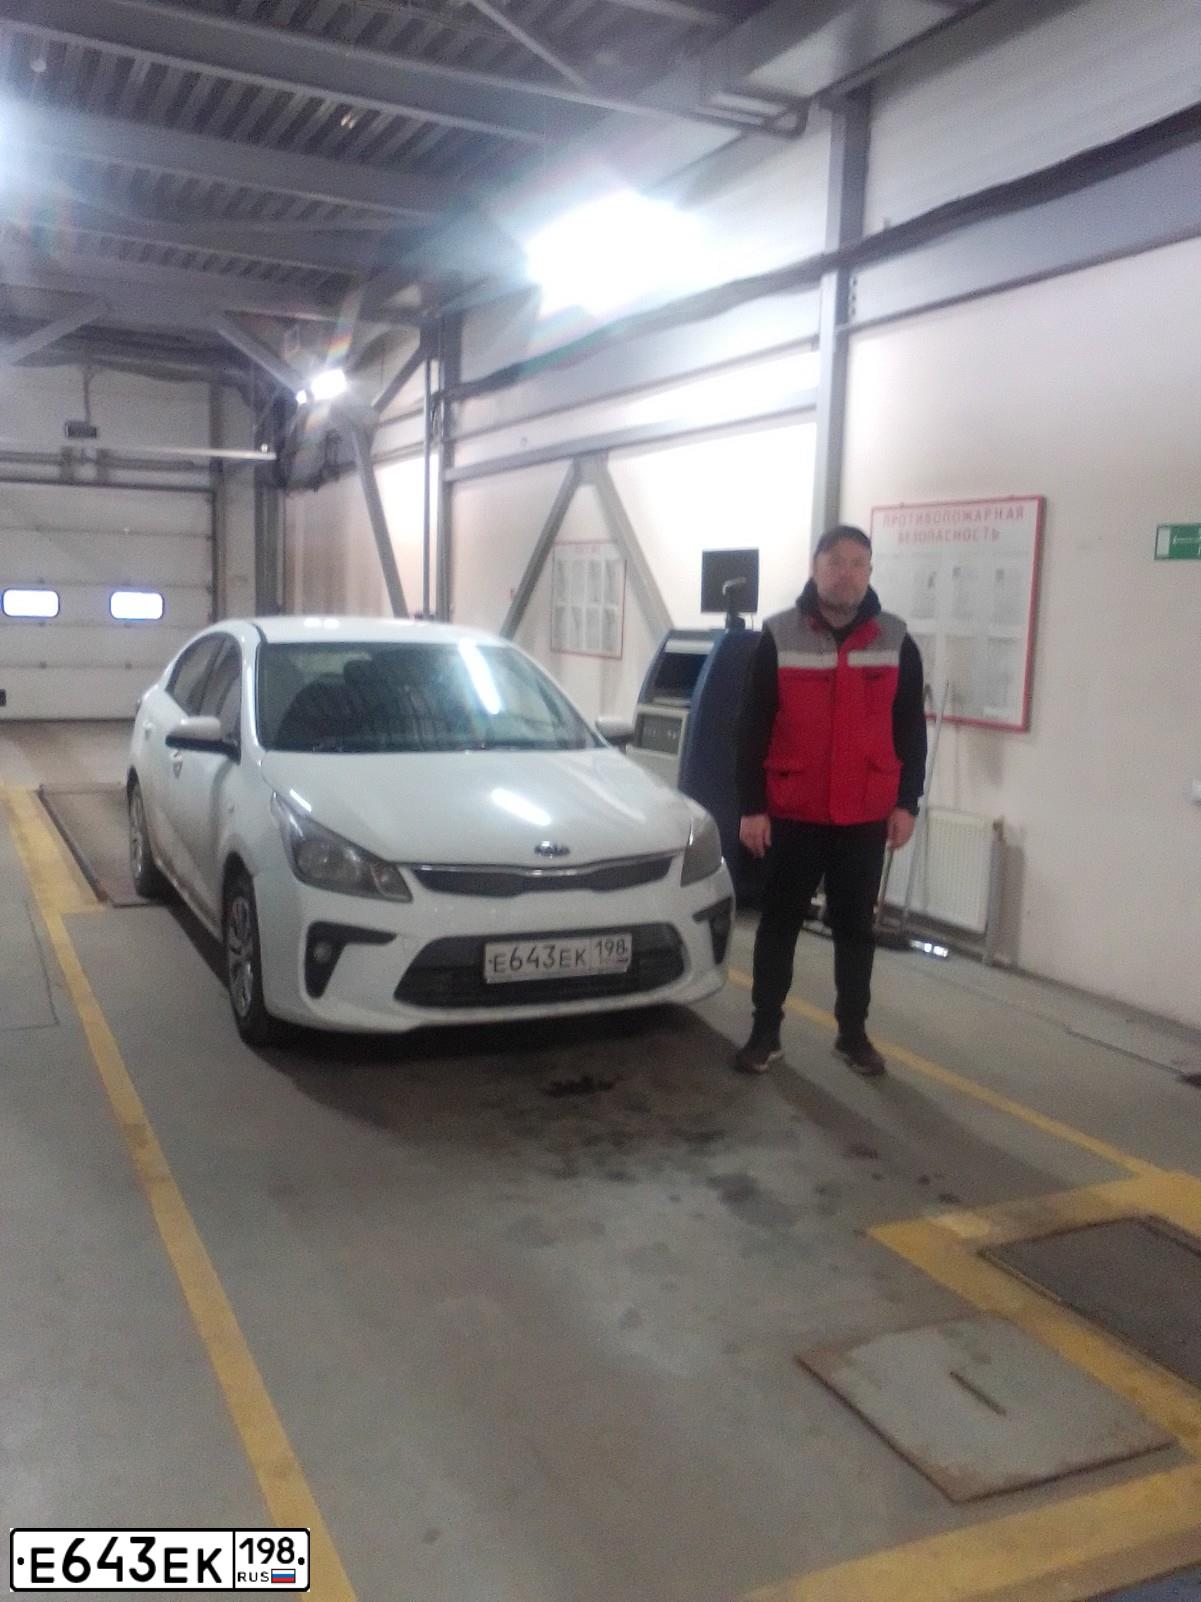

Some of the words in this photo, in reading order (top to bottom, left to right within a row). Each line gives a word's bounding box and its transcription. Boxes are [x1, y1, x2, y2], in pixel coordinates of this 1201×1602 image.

[883, 506, 1024, 528] ПРОТИВОПОЖАРНАЯ
[897, 527, 999, 545] БЕЗОПАСНОСТЬ
[596, 938, 626, 957] 198
